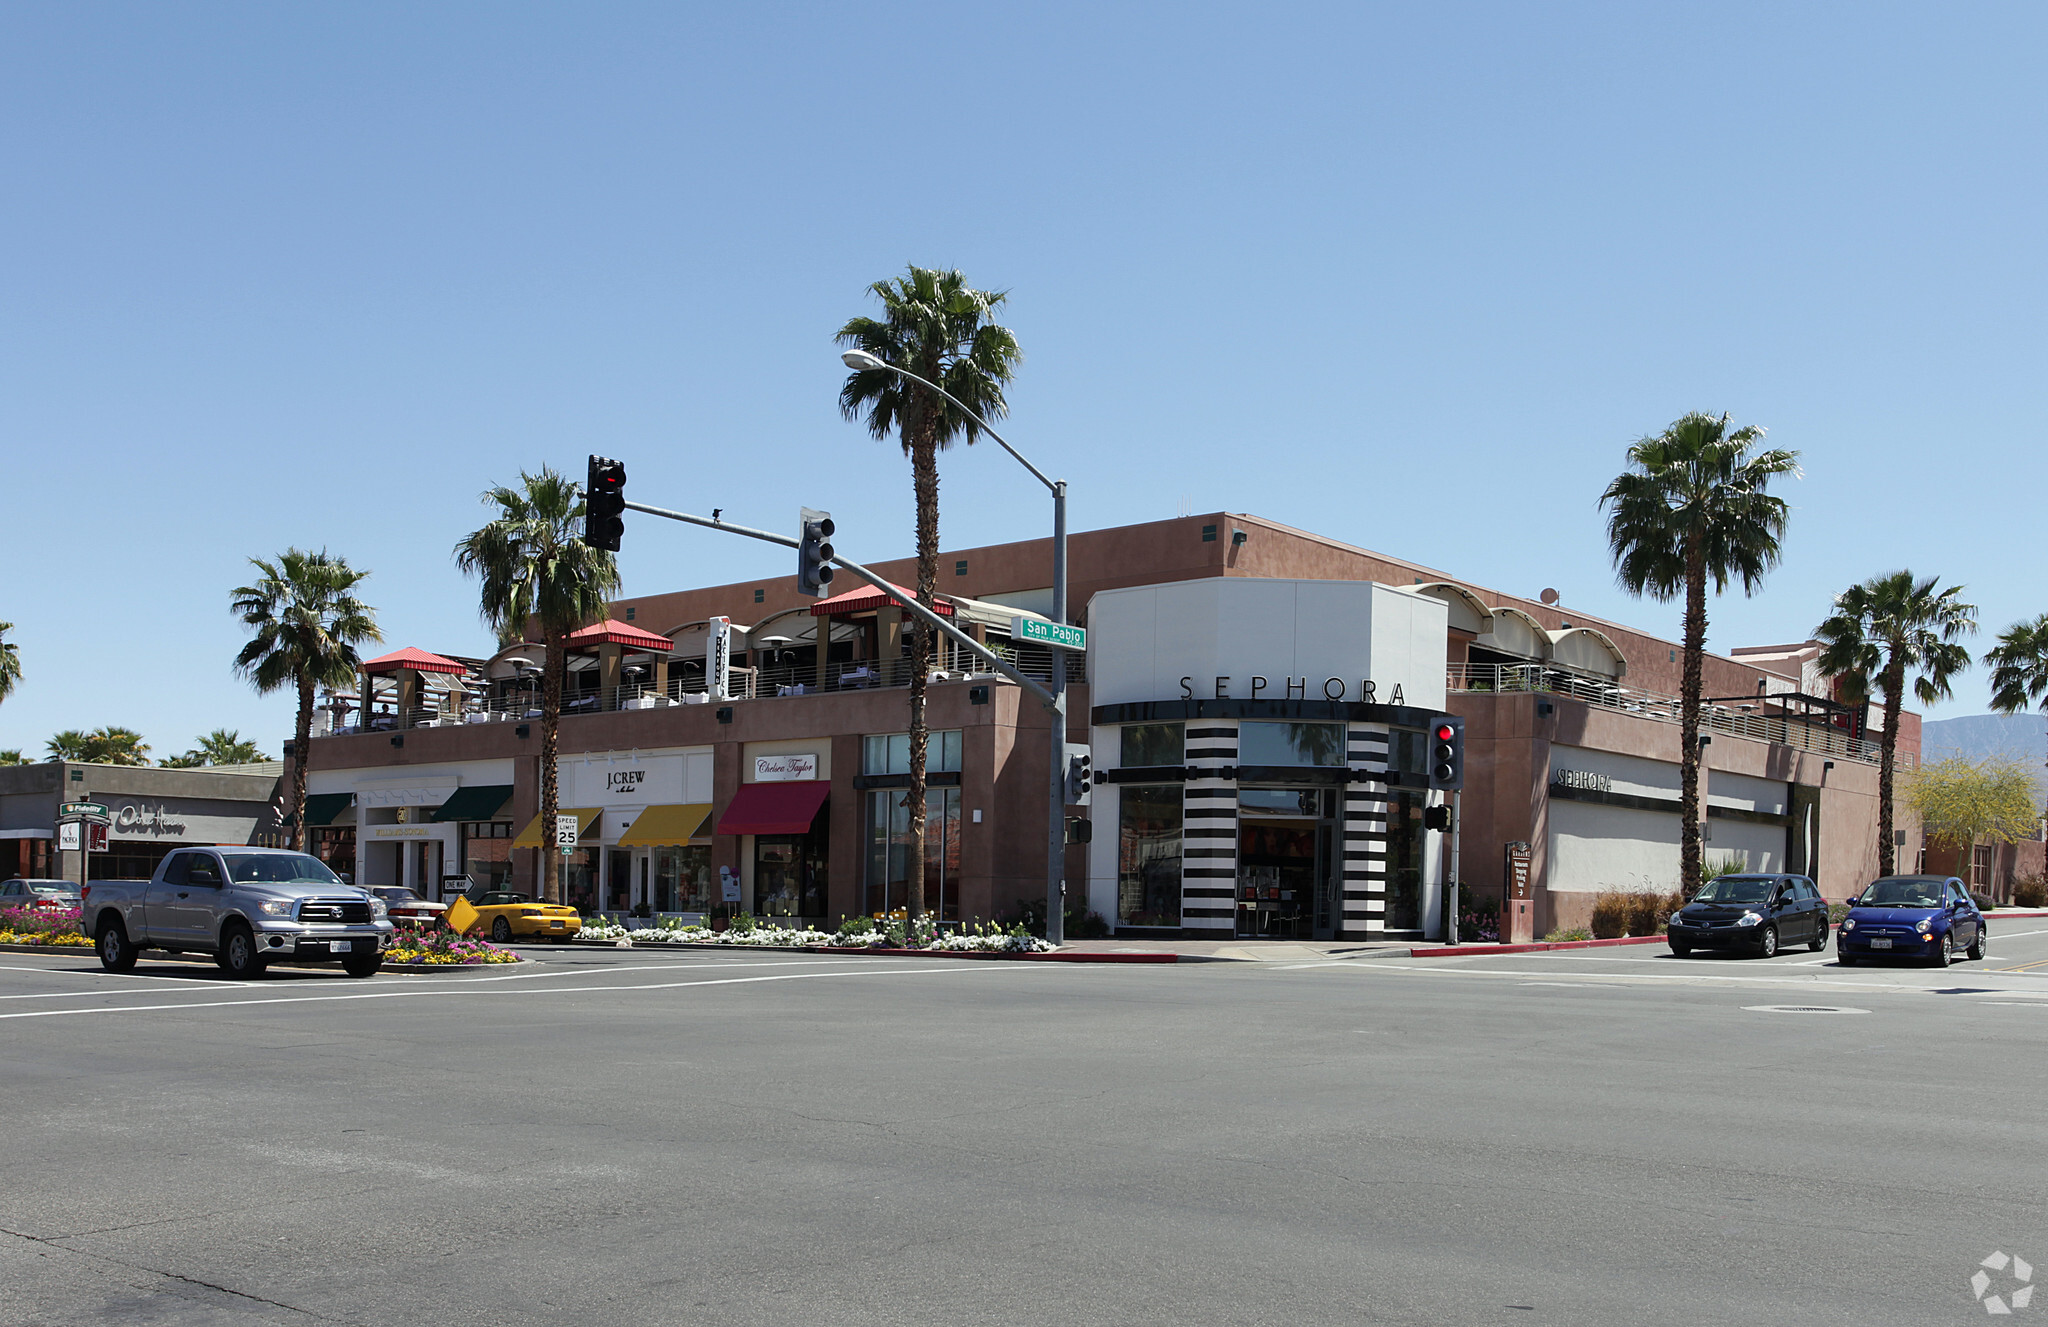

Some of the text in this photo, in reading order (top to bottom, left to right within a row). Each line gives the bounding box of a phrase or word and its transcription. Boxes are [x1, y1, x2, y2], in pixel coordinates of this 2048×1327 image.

[1027, 620, 1080, 641] San Pablo
[1180, 676, 1405, 705] SEPHORA
[757, 759, 813, 777] Chelsea Taylor
[606, 771, 645, 790] J.CREW
[1557, 769, 1612, 792] SEPHORA
[74, 805, 102, 813] Fidelity
[559, 832, 575, 843] 25
